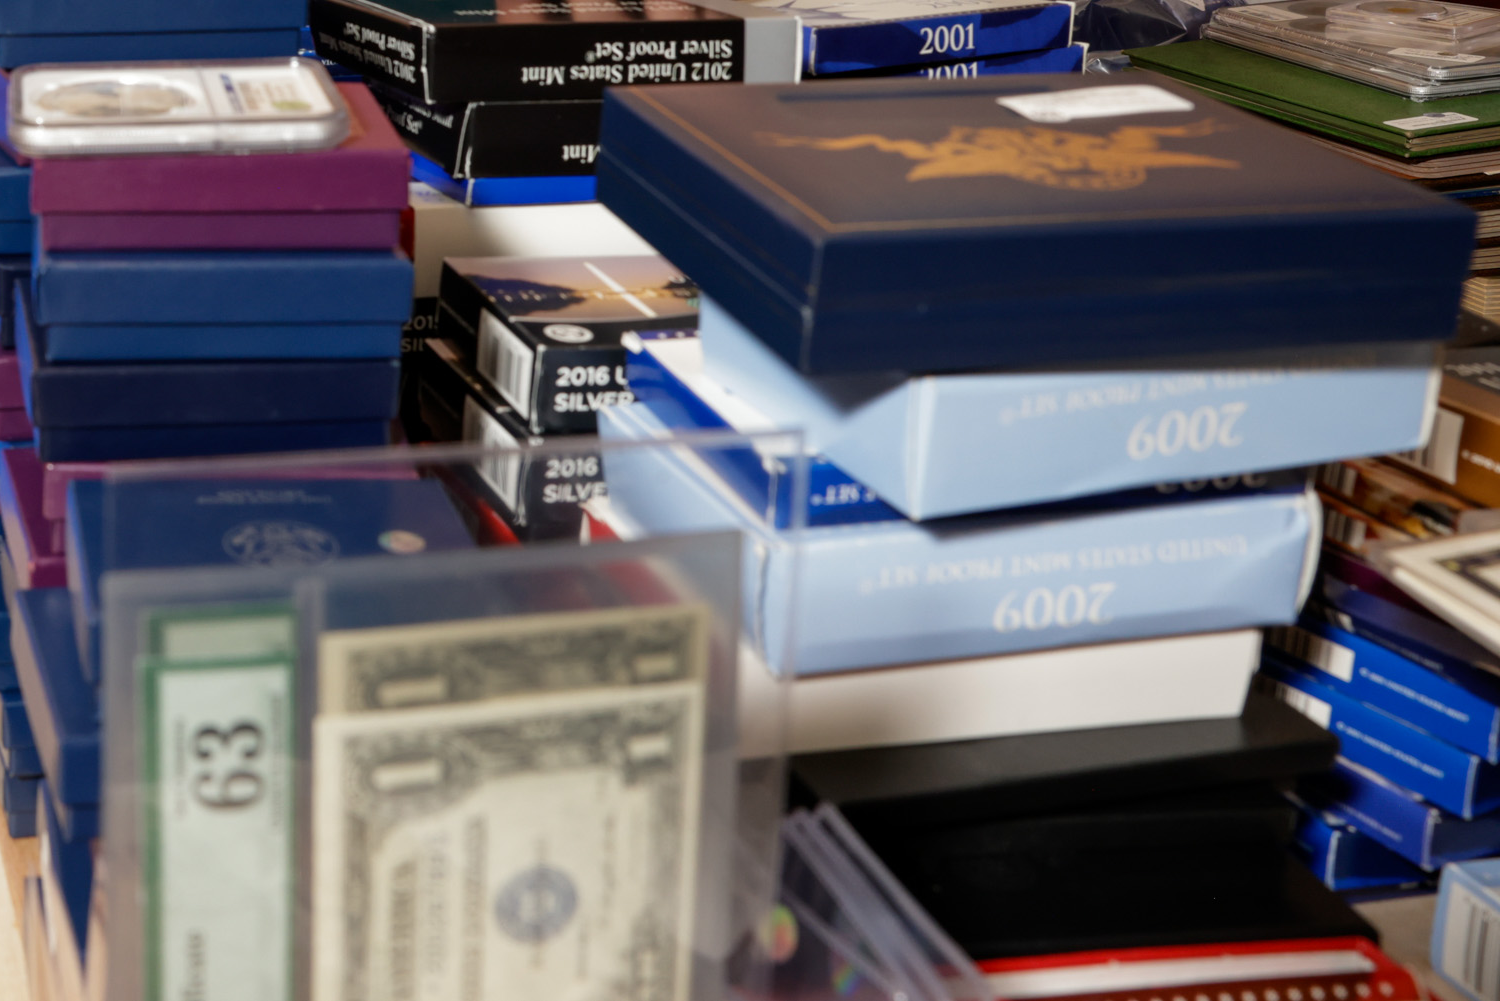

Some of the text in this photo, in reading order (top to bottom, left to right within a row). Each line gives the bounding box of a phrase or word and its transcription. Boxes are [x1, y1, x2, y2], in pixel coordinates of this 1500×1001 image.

[628, 39, 675, 59] Proof
[680, 38, 733, 59] Silver
[919, 22, 975, 56] 2001
[521, 60, 733, 85] 2012 United States Mint
[555, 365, 610, 387] 2016
[1126, 401, 1247, 461] 2009
[544, 455, 599, 479] 2016
[1011, 551, 1072, 579] MINT
[1076, 543, 1153, 572] STATES
[1157, 535, 1249, 566] UNITED
[926, 556, 1005, 585] PROOF
[991, 582, 1117, 633] 2009
[195, 716, 268, 815] 63
